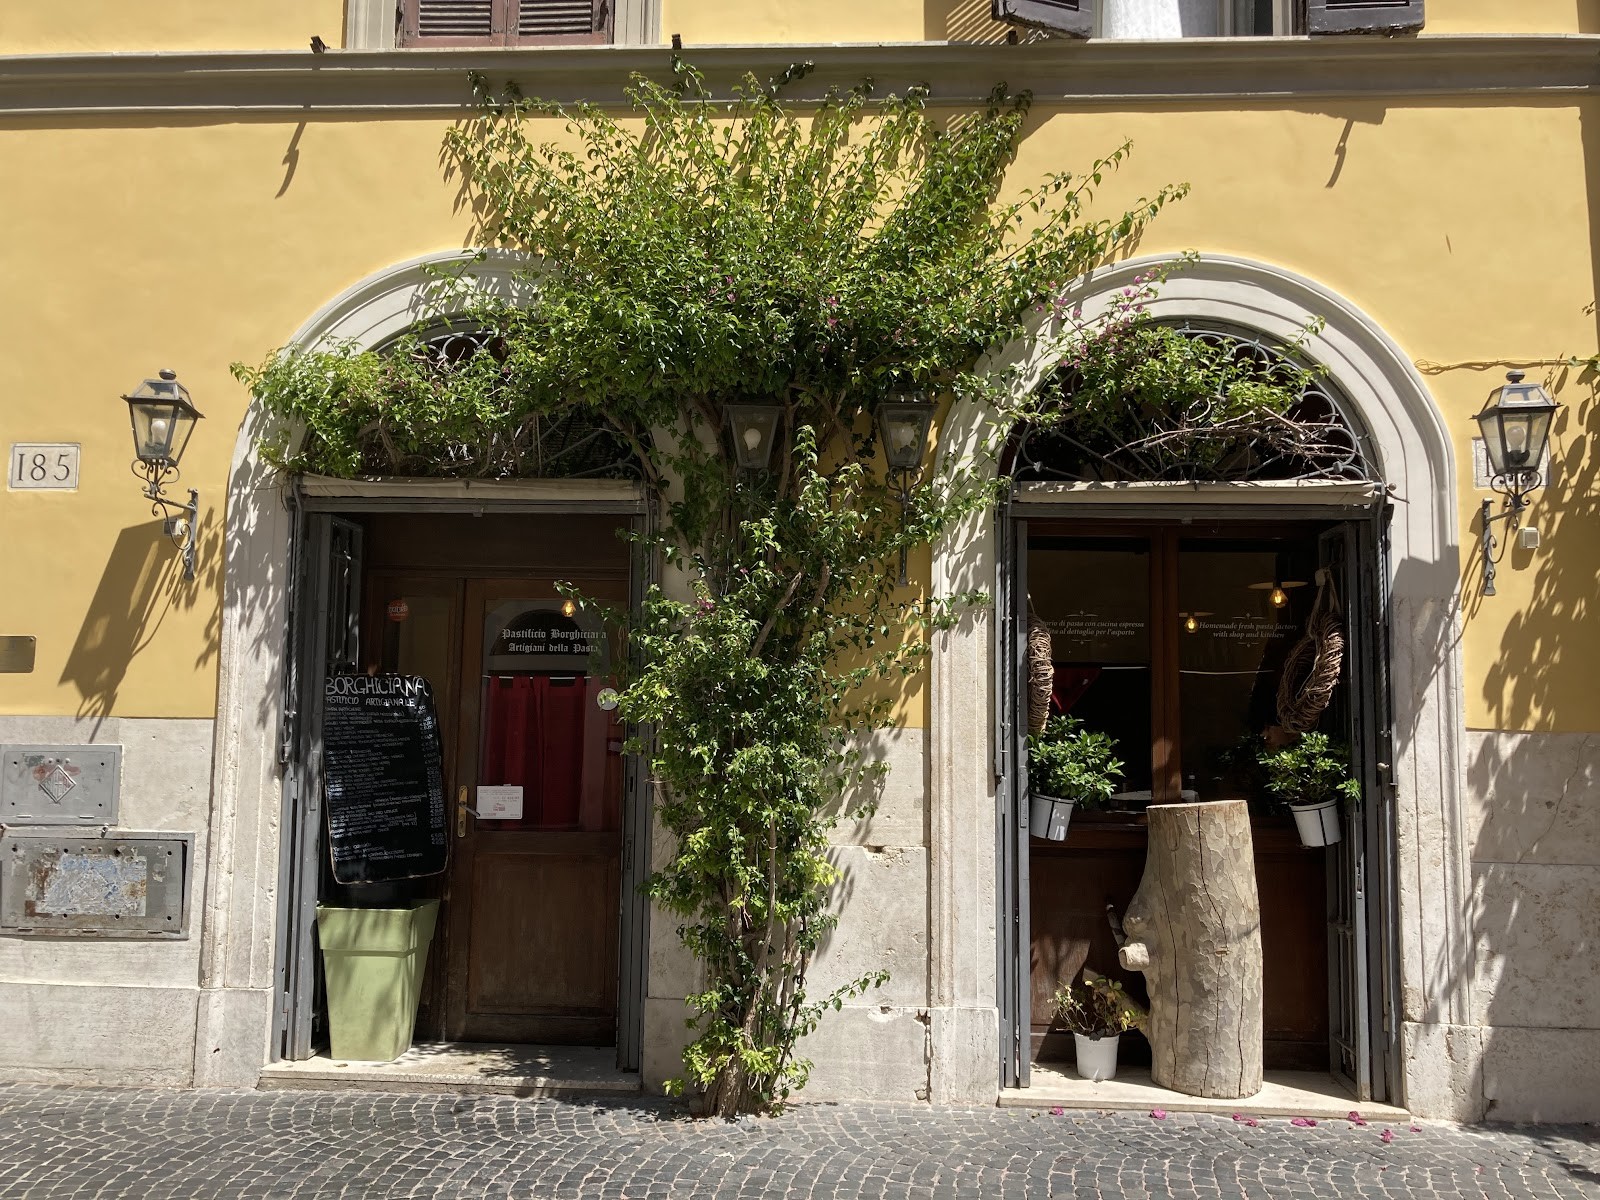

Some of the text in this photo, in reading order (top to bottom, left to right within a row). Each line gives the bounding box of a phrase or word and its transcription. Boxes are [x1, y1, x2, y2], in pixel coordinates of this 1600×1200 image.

[17, 453, 70, 482] 185
[1096, 620, 1118, 628] cucina
[1119, 621, 1145, 629] espressa
[1199, 621, 1298, 631] Homemade fresh pasta factory
[501, 628, 546, 640] Pastificio
[1066, 628, 1095, 637] dettaglio
[1095, 629, 1107, 637] per
[1228, 631, 1245, 639] shop
[1260, 631, 1285, 639] kitchen
[508, 642, 546, 654] Artigiani
[549, 643, 569, 653] della
[325, 676, 429, 697] BORGHICIANA
